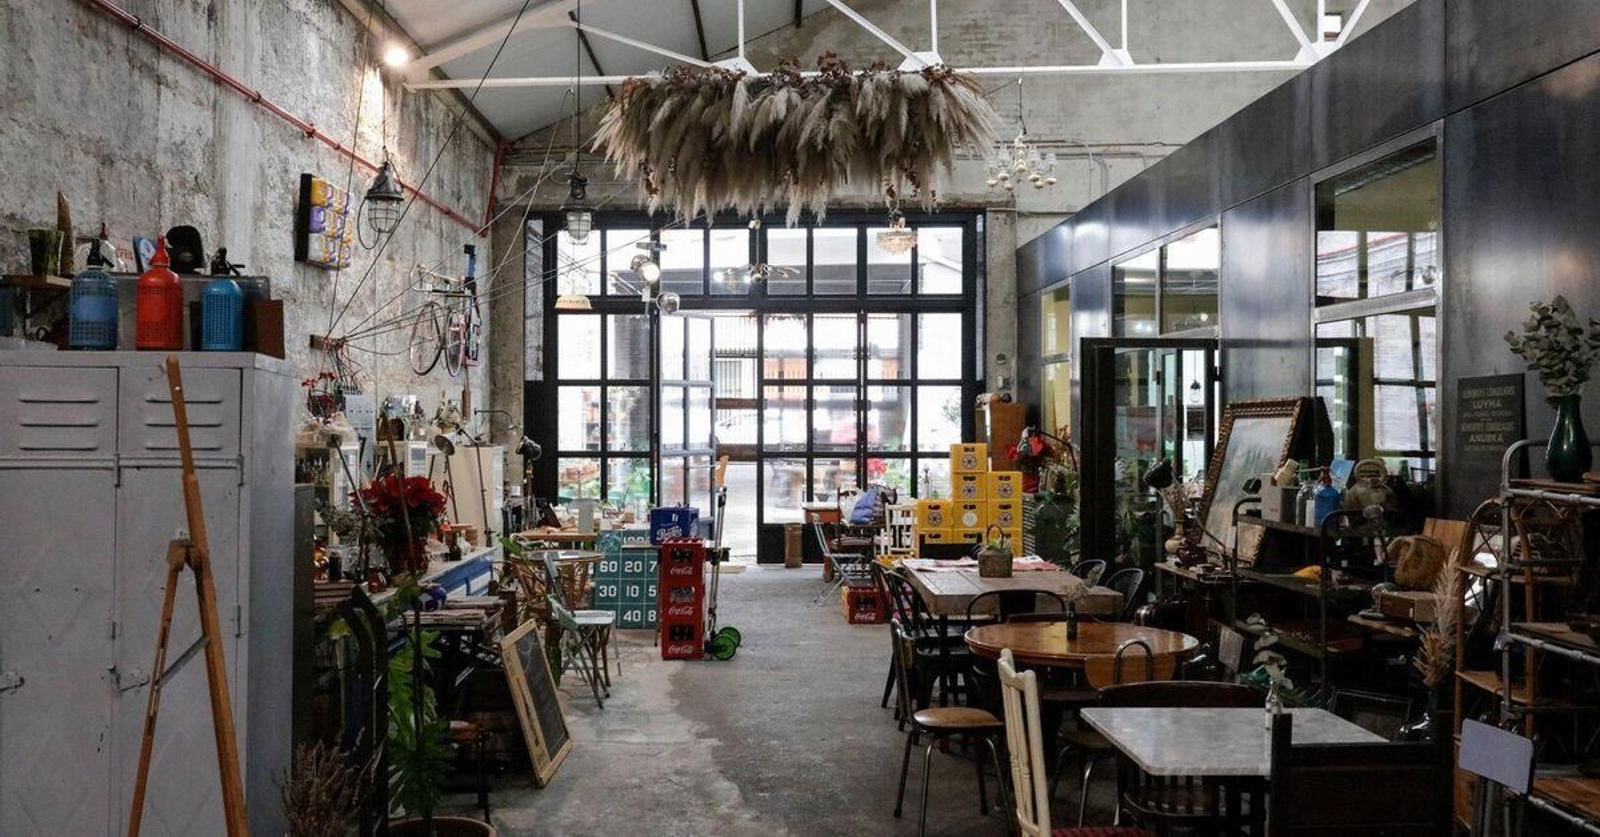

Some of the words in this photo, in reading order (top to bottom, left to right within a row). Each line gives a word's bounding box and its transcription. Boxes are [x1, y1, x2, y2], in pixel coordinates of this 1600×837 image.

[600, 561, 617, 572] 60
[624, 561, 642, 572] 20
[649, 561, 657, 572] 7
[599, 585, 617, 597] 30
[626, 586, 639, 597] 10
[649, 585, 657, 597] 5
[623, 610, 641, 622] 40
[648, 610, 657, 621] 8
